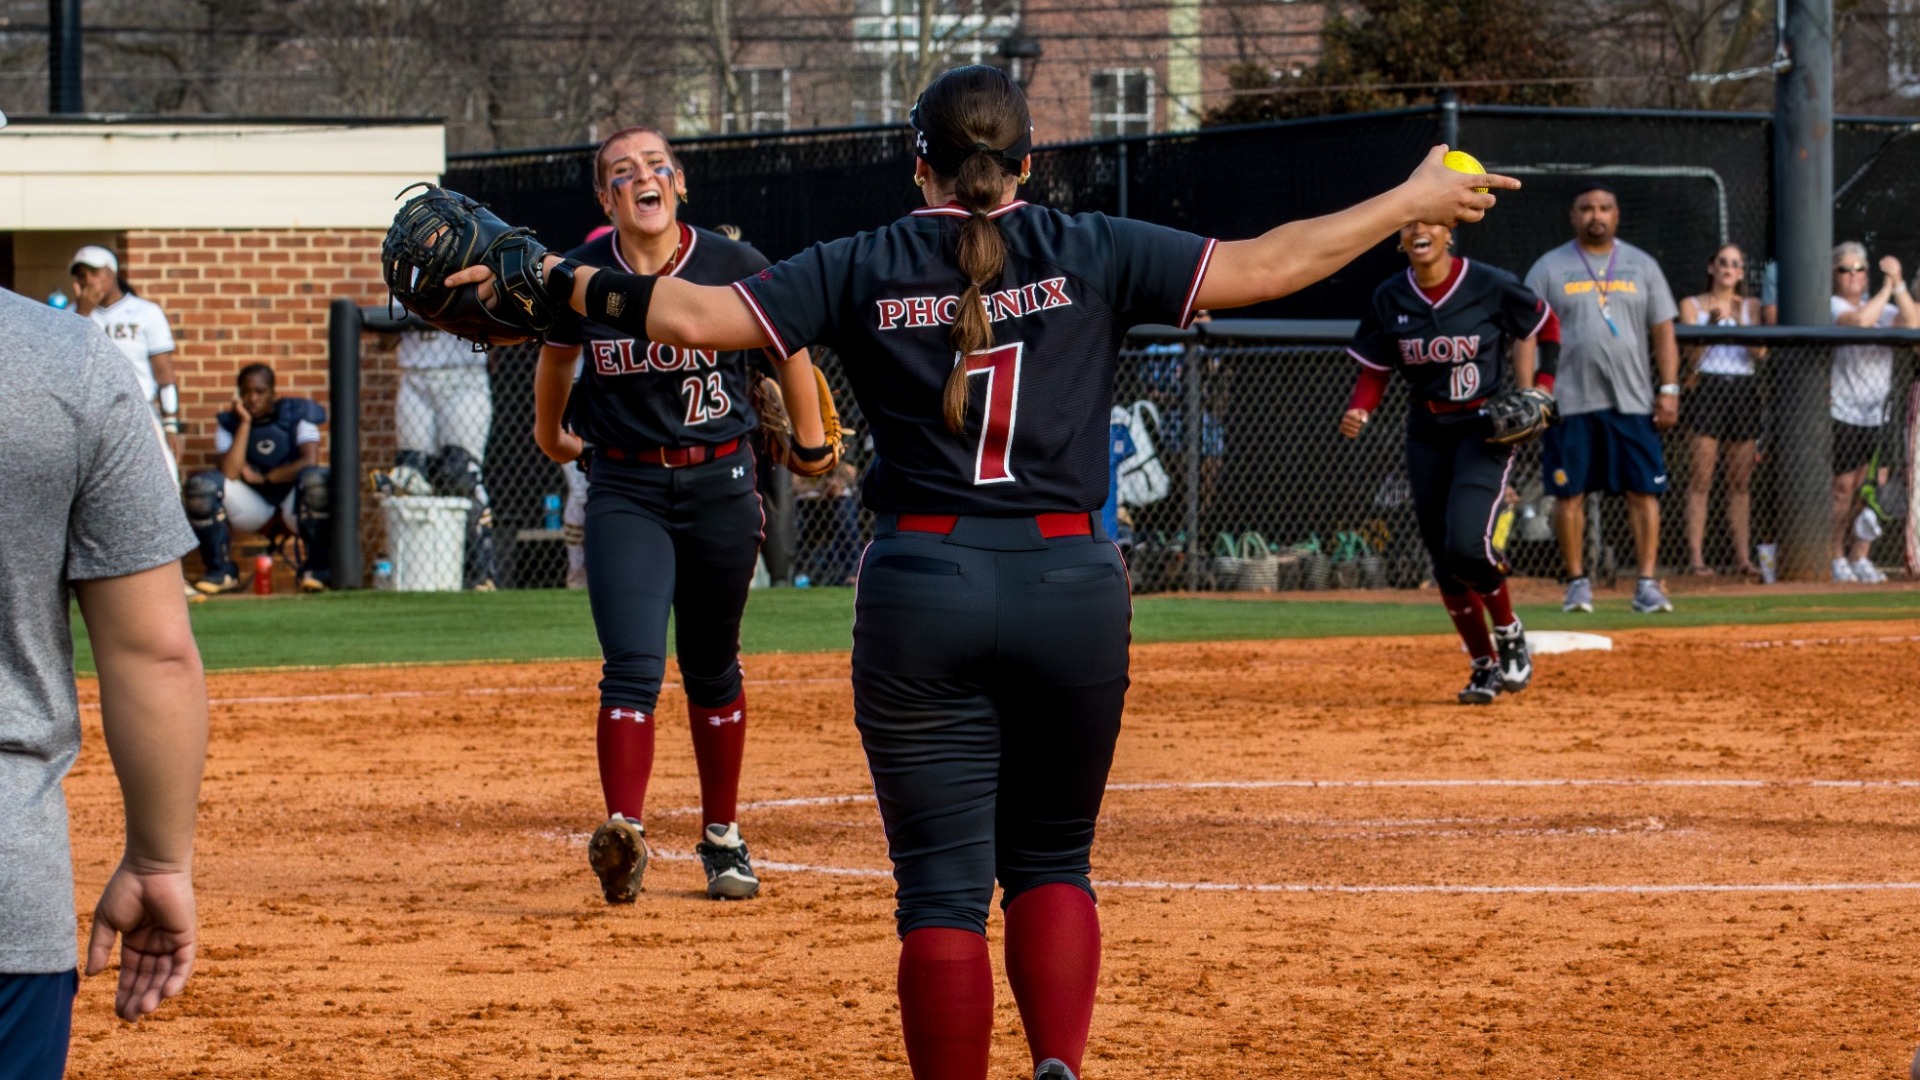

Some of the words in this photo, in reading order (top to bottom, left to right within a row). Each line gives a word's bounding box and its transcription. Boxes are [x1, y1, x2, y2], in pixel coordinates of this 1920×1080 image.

[591, 339, 717, 375] ELON
[1398, 335, 1480, 365] ELON
[682, 371, 731, 426] 23
[1450, 362, 1480, 401] 19
[954, 341, 1023, 485] 7
